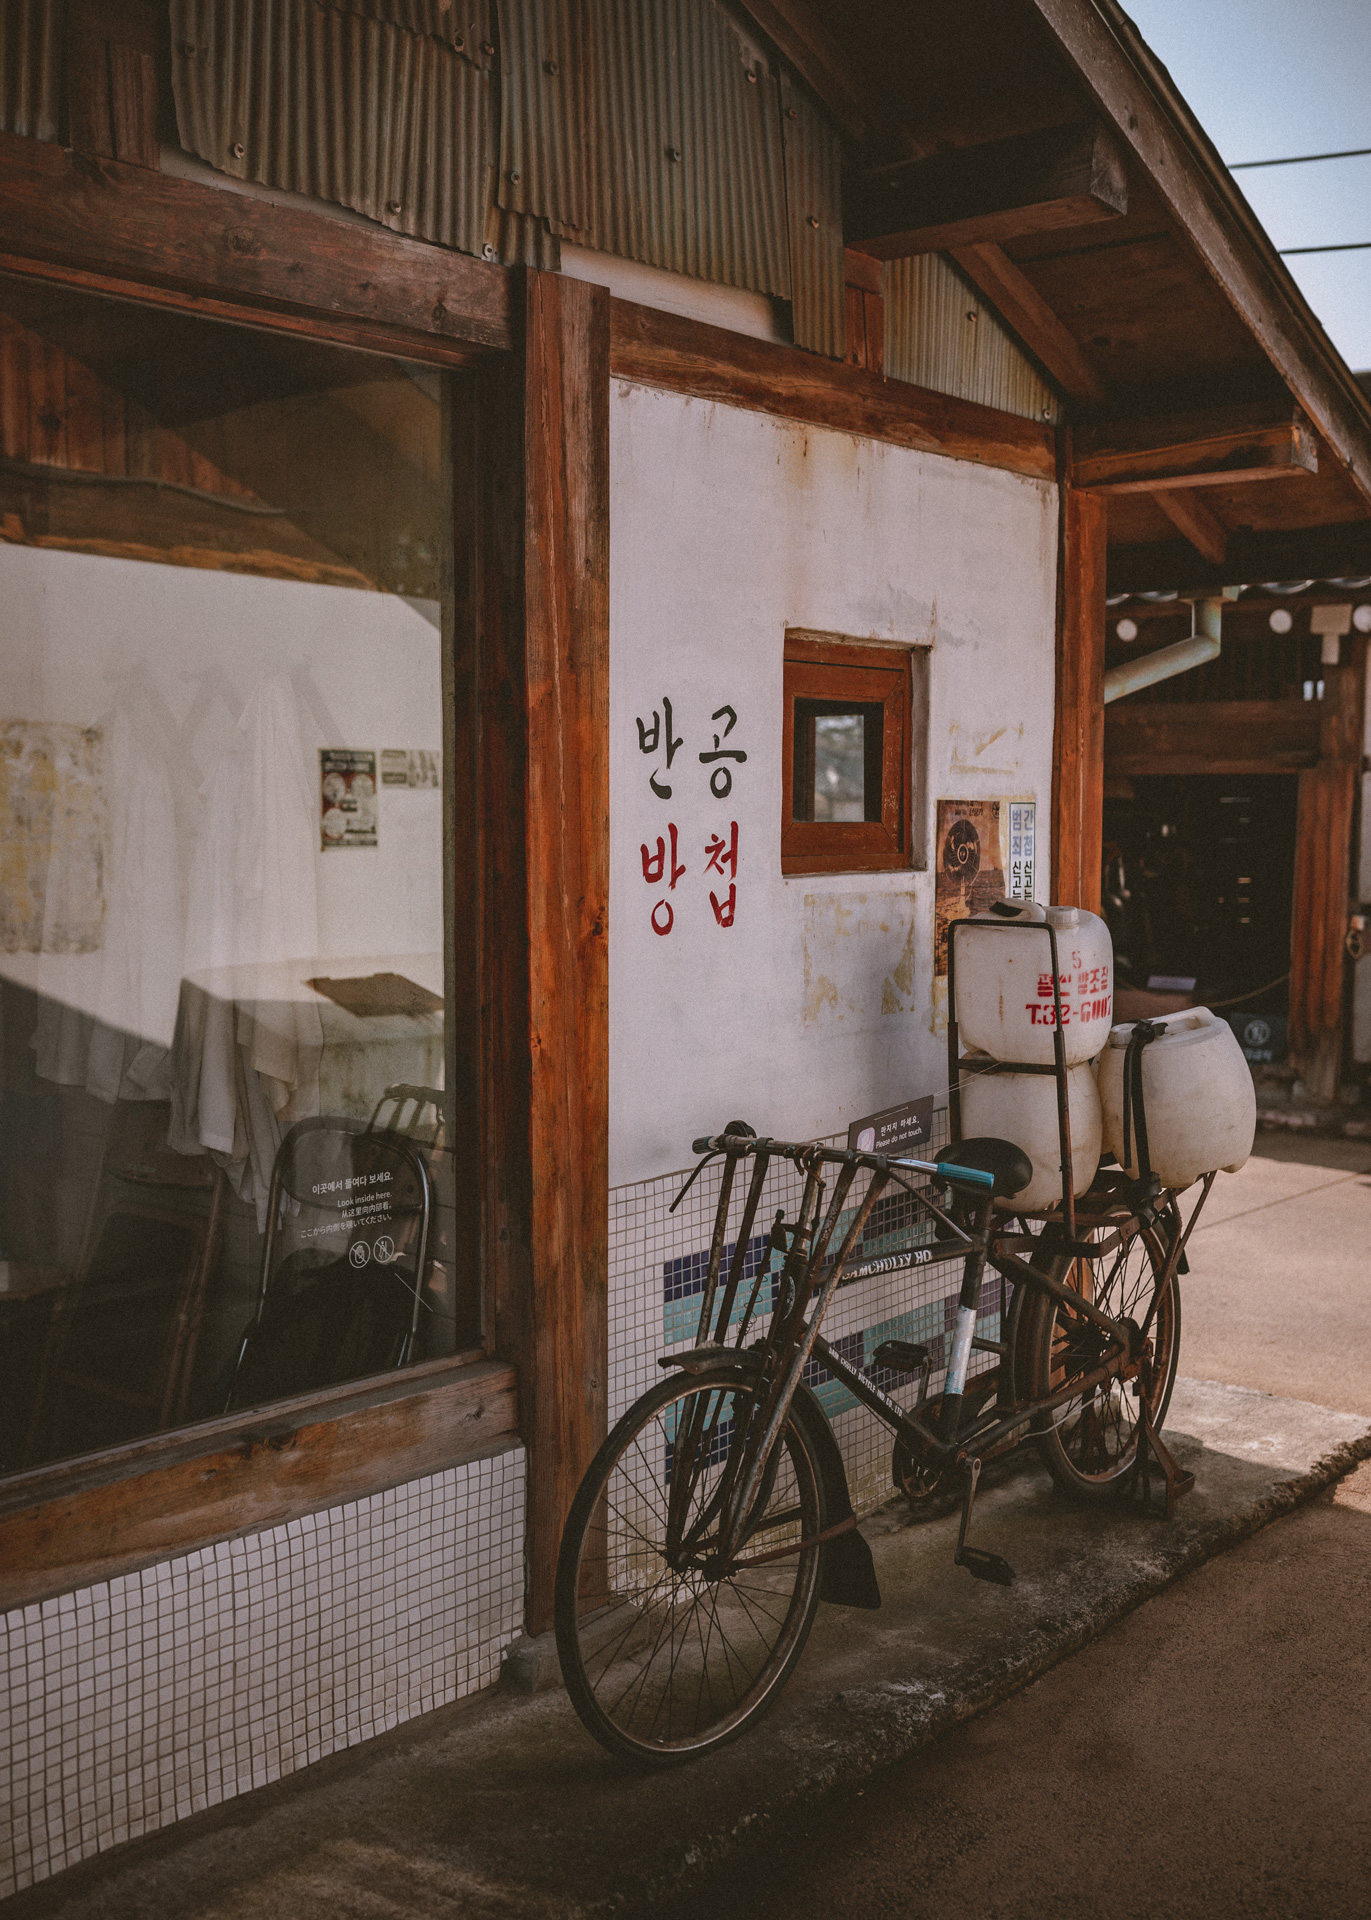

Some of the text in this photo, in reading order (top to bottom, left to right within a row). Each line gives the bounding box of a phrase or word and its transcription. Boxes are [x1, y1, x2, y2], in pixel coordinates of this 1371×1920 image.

[880, 1115, 920, 1137] 만지지 마세요.
[875, 1139, 890, 1149] Please
[891, 1134, 898, 1144] do
[898, 1132, 907, 1141] not
[312, 1171, 394, 1195] 이곳에서 들여다 보세요.
[337, 1191, 392, 1208] Look inside here.
[857, 1372, 876, 1394] BICYCLE
